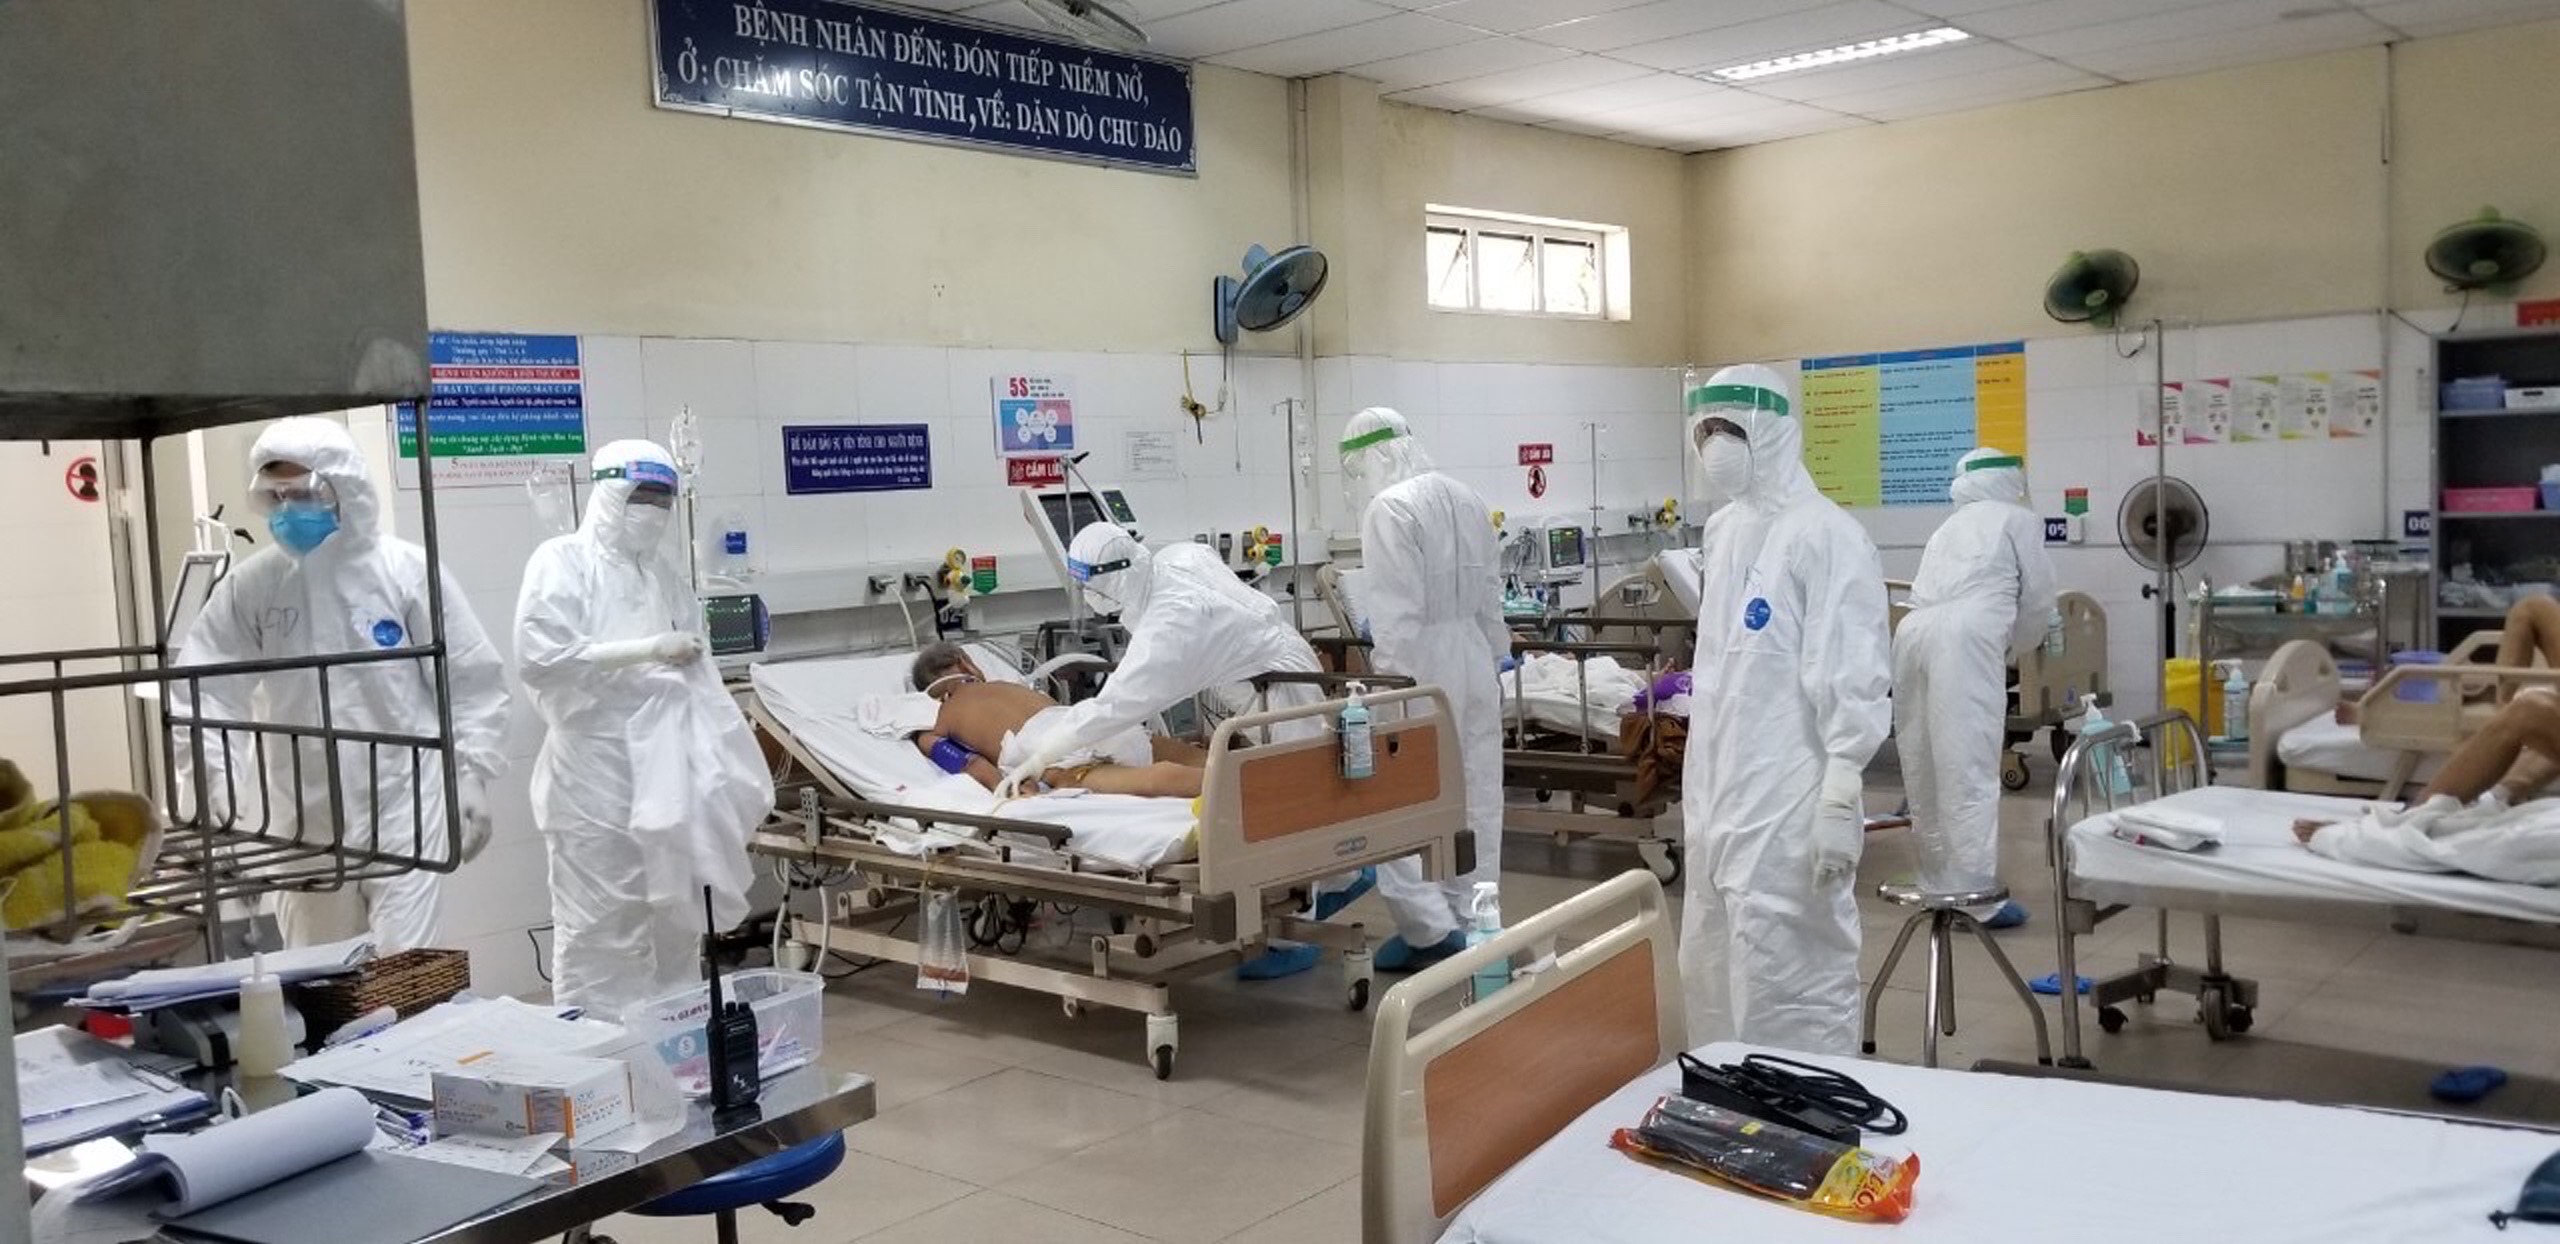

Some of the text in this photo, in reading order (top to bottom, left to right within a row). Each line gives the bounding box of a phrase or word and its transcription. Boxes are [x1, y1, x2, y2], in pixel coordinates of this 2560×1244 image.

[733, 0, 1149, 108] BỆNH NHÂN ĐẾN: ĐÓN TIẾP NIỀM NỞ,
[713, 54, 793, 98] CHĂM
[799, 63, 849, 106] SÓC
[855, 72, 904, 120] TẬN
[1016, 98, 1060, 141] DẶN
[1066, 105, 1094, 141] DÒ
[1099, 116, 1140, 148] CHU
[1143, 118, 1182, 153] ĐÁO
[1010, 377, 1029, 397] 5S
[2048, 523, 2067, 537] 05
[2408, 516, 2431, 531] 06
